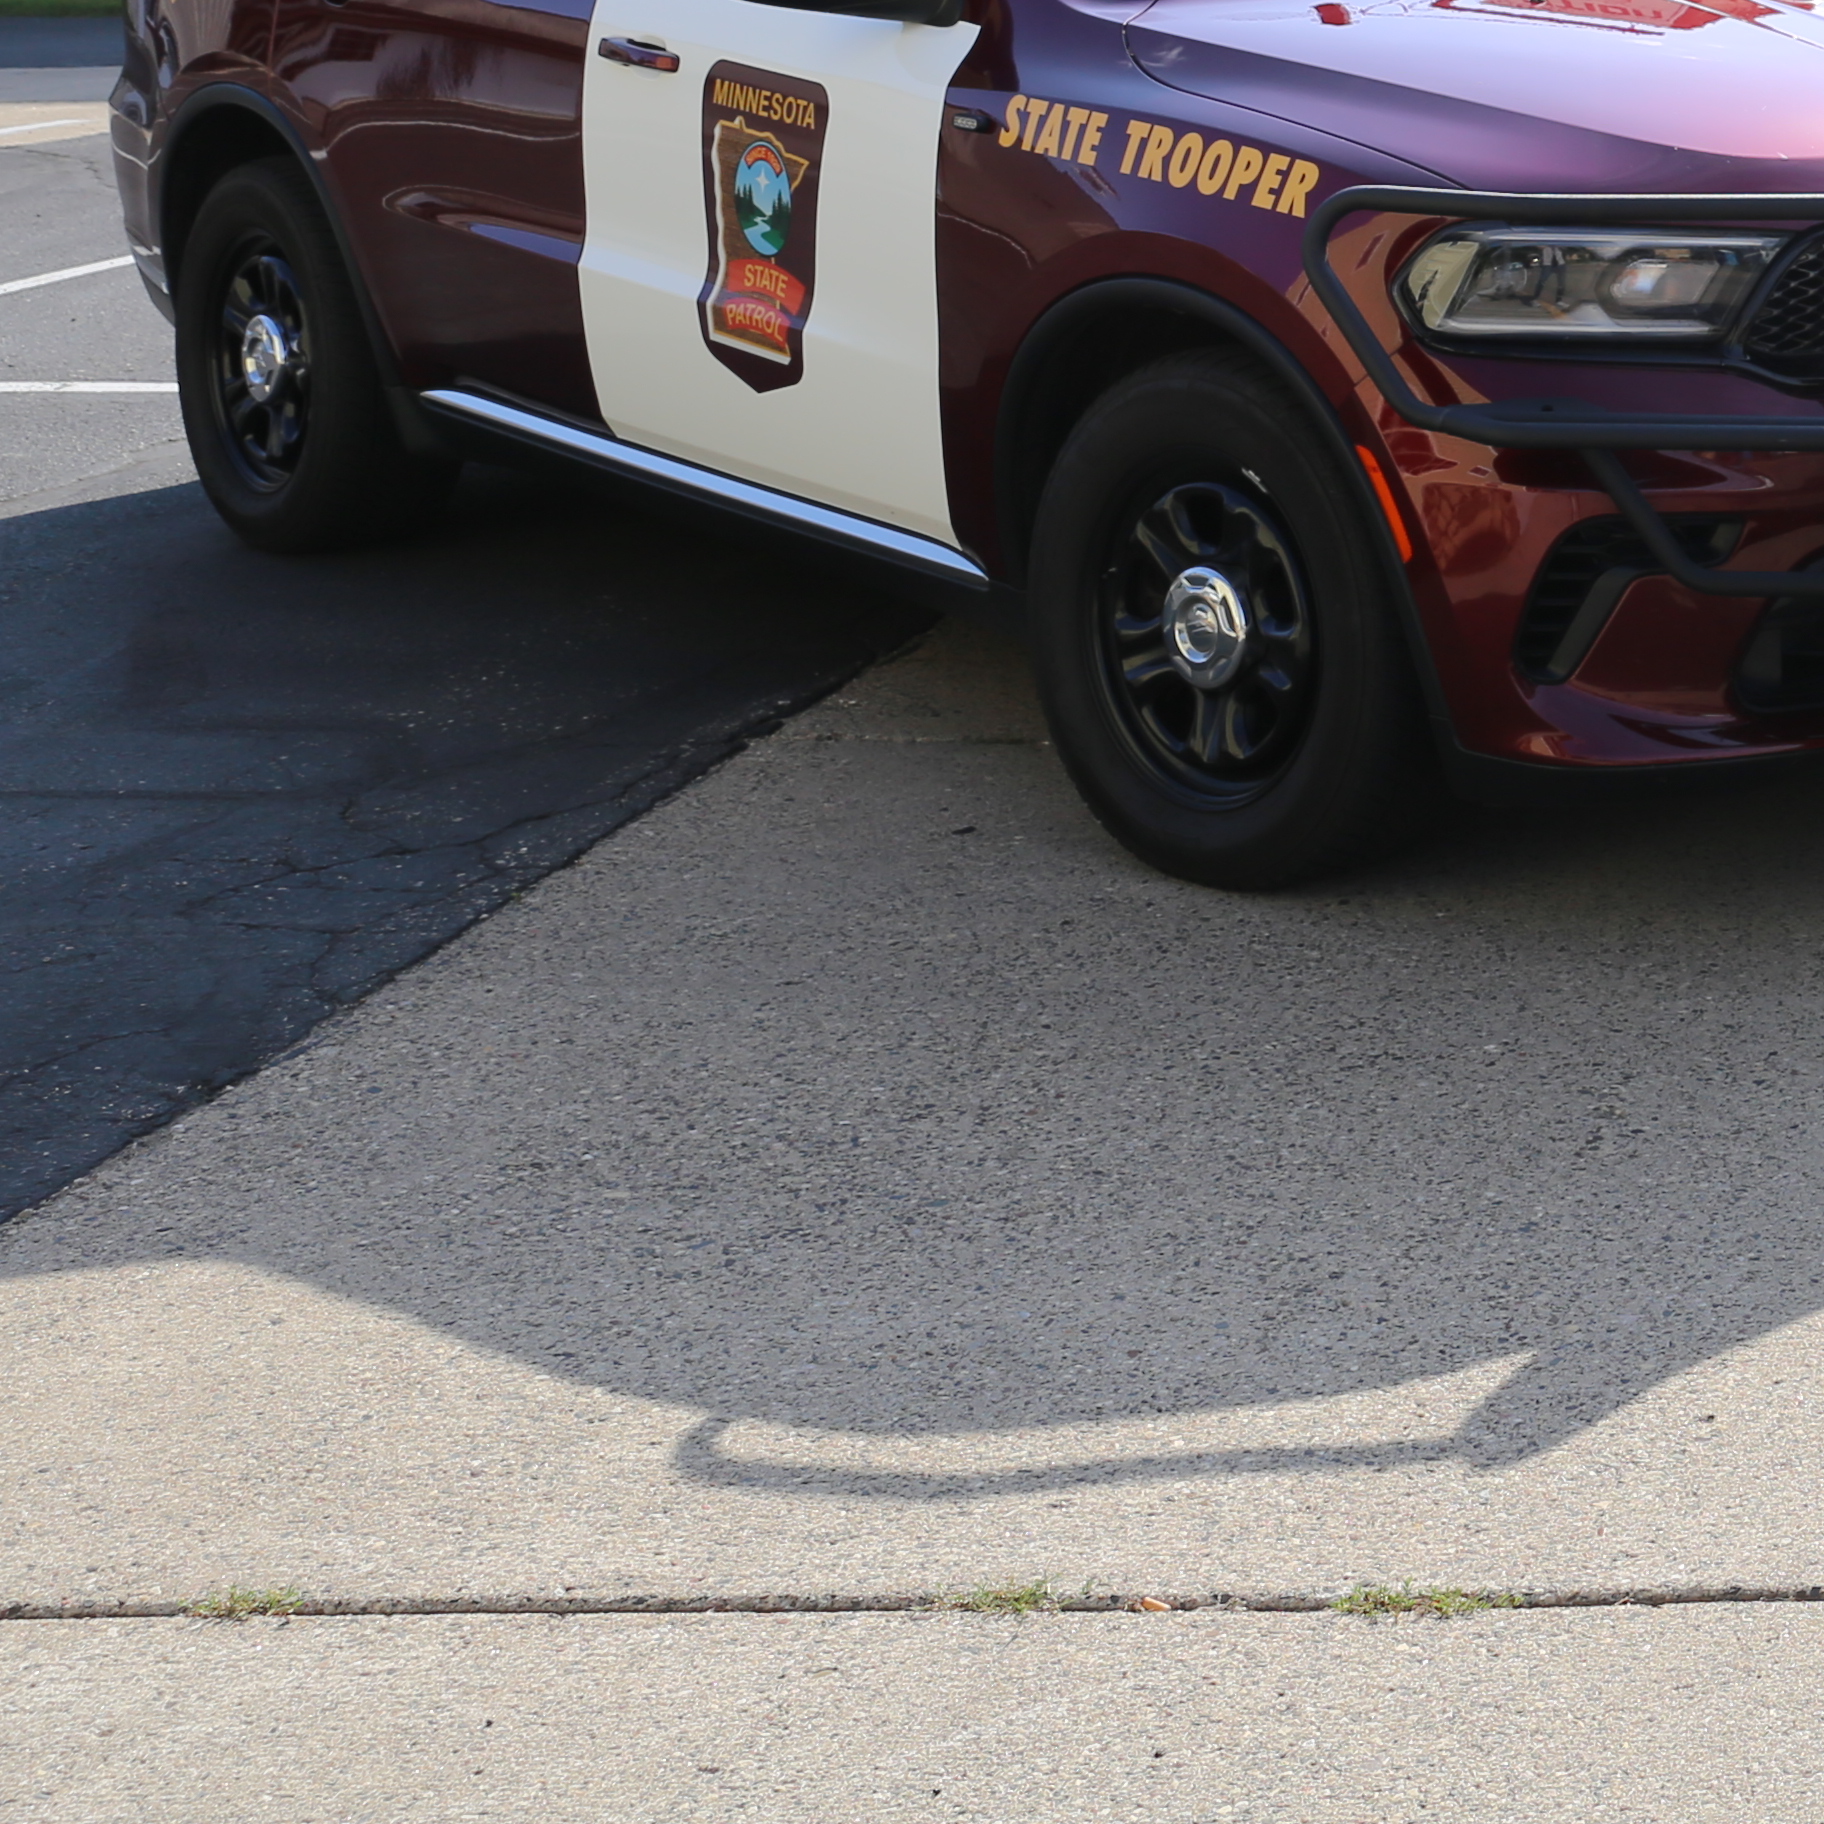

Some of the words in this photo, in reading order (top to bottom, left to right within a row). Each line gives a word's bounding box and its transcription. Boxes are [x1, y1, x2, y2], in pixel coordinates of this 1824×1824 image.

[713, 78, 815, 130] MINNESOTA
[998, 94, 1108, 166] STATE
[1119, 119, 1320, 218] TROOPER
[744, 264, 788, 298] STATE
[726, 303, 784, 342] PATROL
